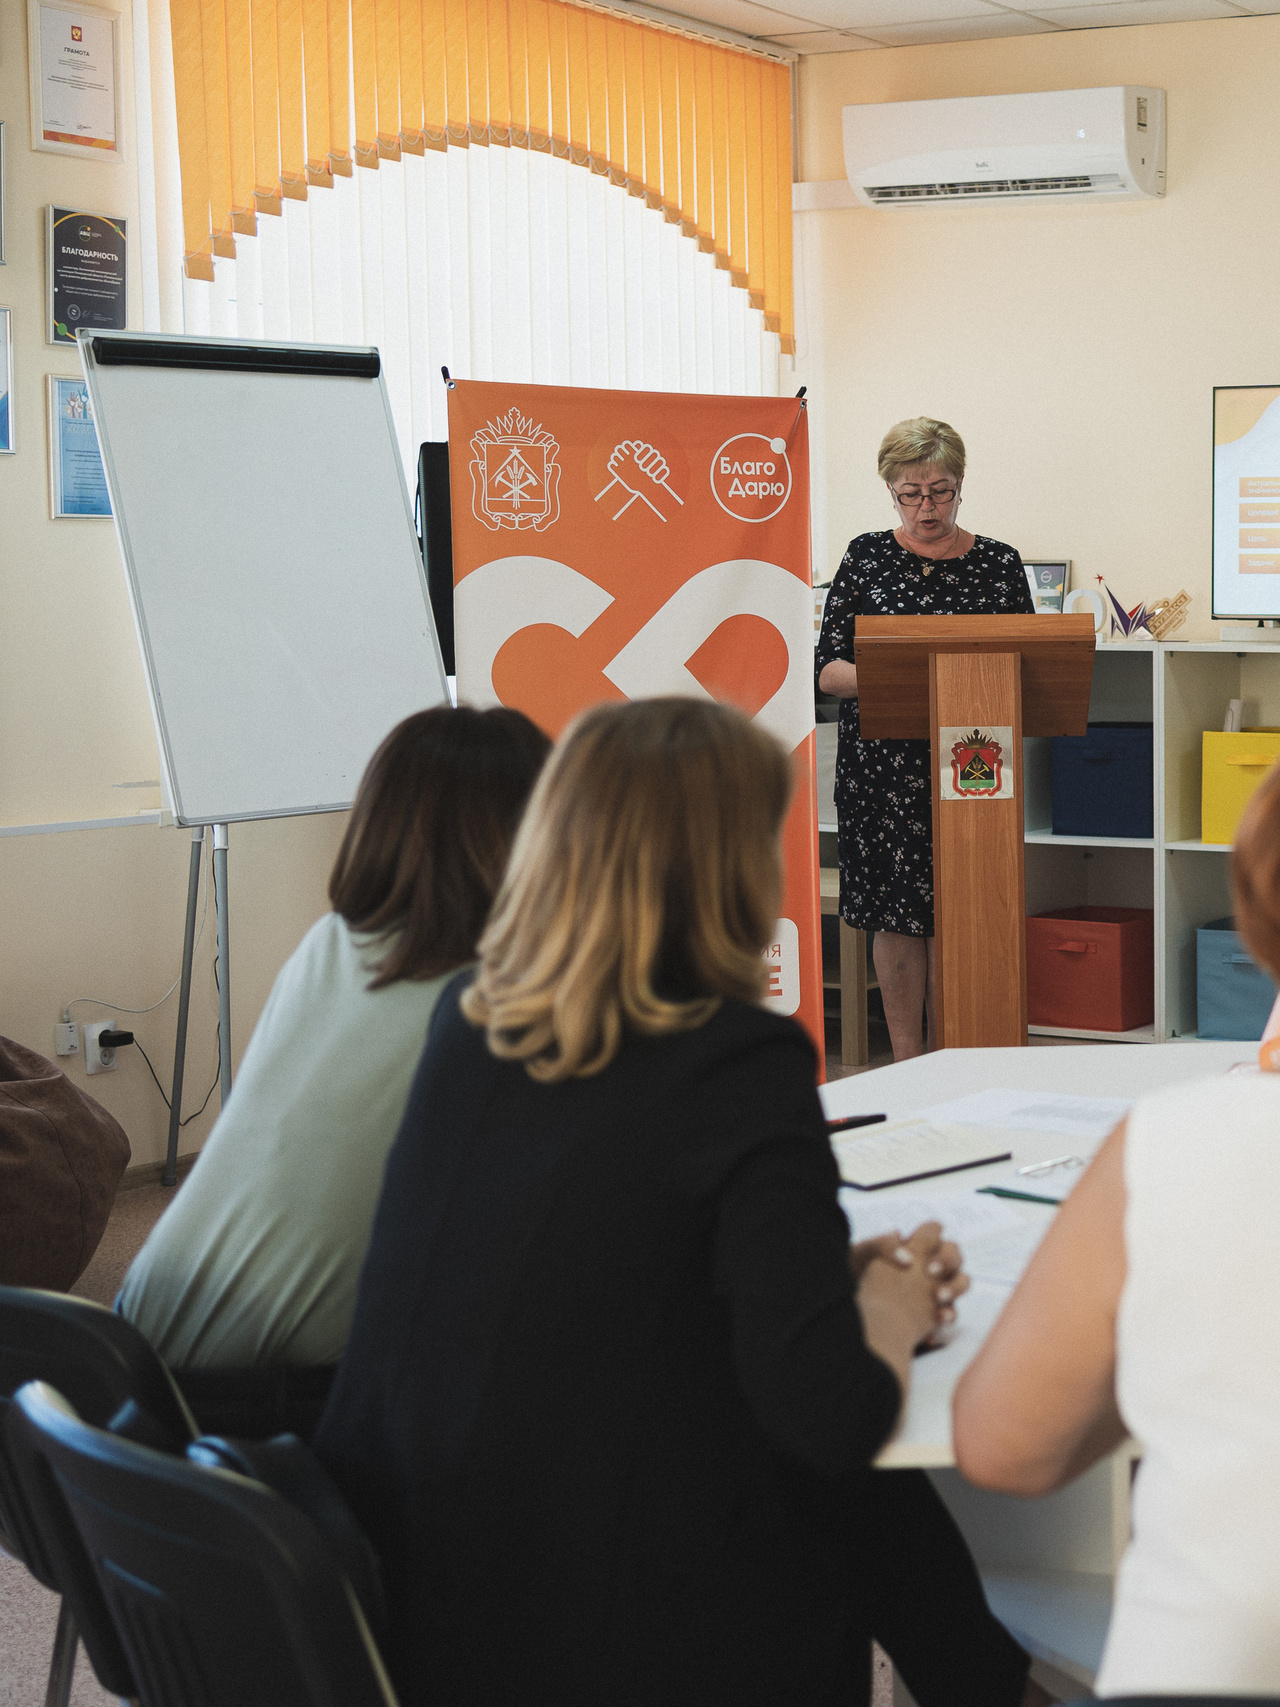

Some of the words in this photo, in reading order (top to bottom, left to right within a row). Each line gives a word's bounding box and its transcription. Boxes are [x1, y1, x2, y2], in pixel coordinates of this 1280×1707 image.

[64, 47, 90, 57] ГРАМОТА
[61, 246, 119, 262] БЛАГОДАРНОСТЬ
[720, 457, 776, 476] Благо
[728, 478, 785, 500] Дарю
